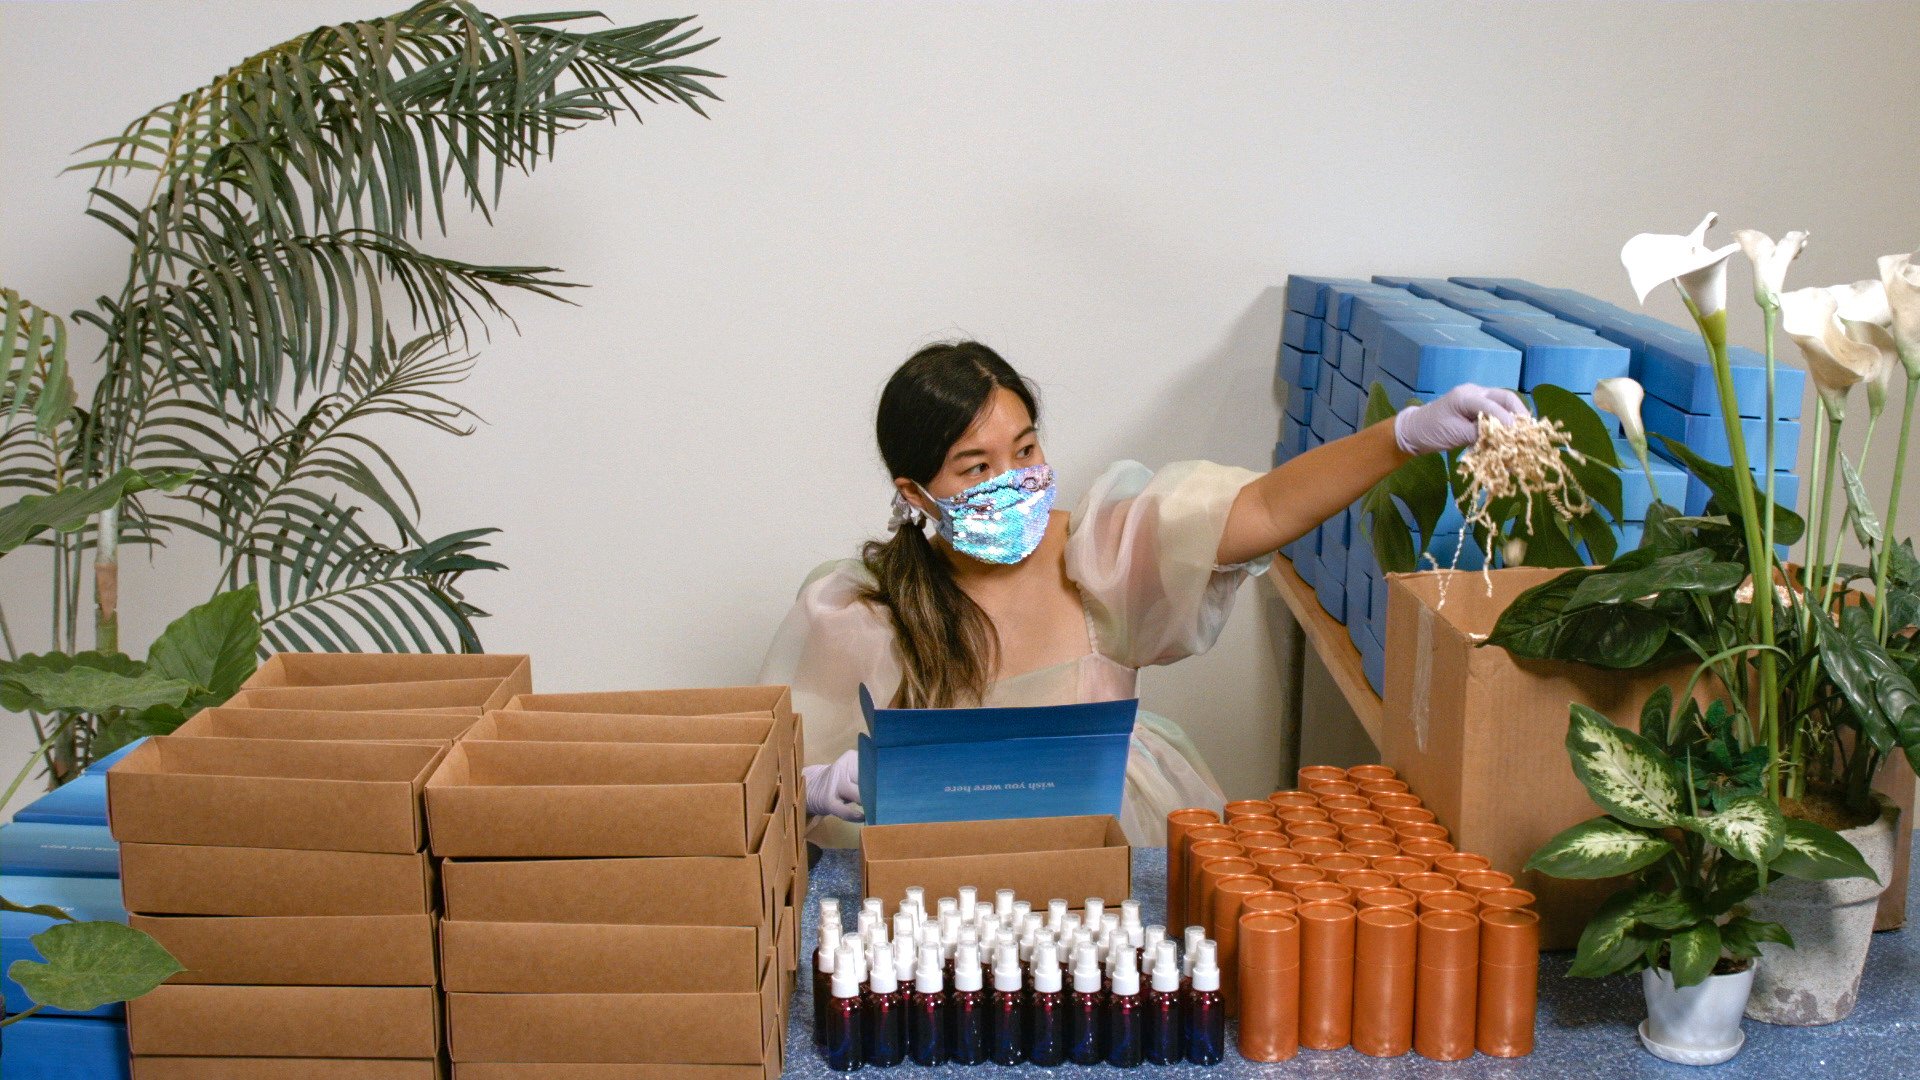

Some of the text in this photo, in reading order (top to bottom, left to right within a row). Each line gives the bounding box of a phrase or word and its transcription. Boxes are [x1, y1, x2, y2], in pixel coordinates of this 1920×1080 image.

[944, 784, 971, 793] here
[1004, 781, 1026, 790] you
[1028, 781, 1055, 790] wish
